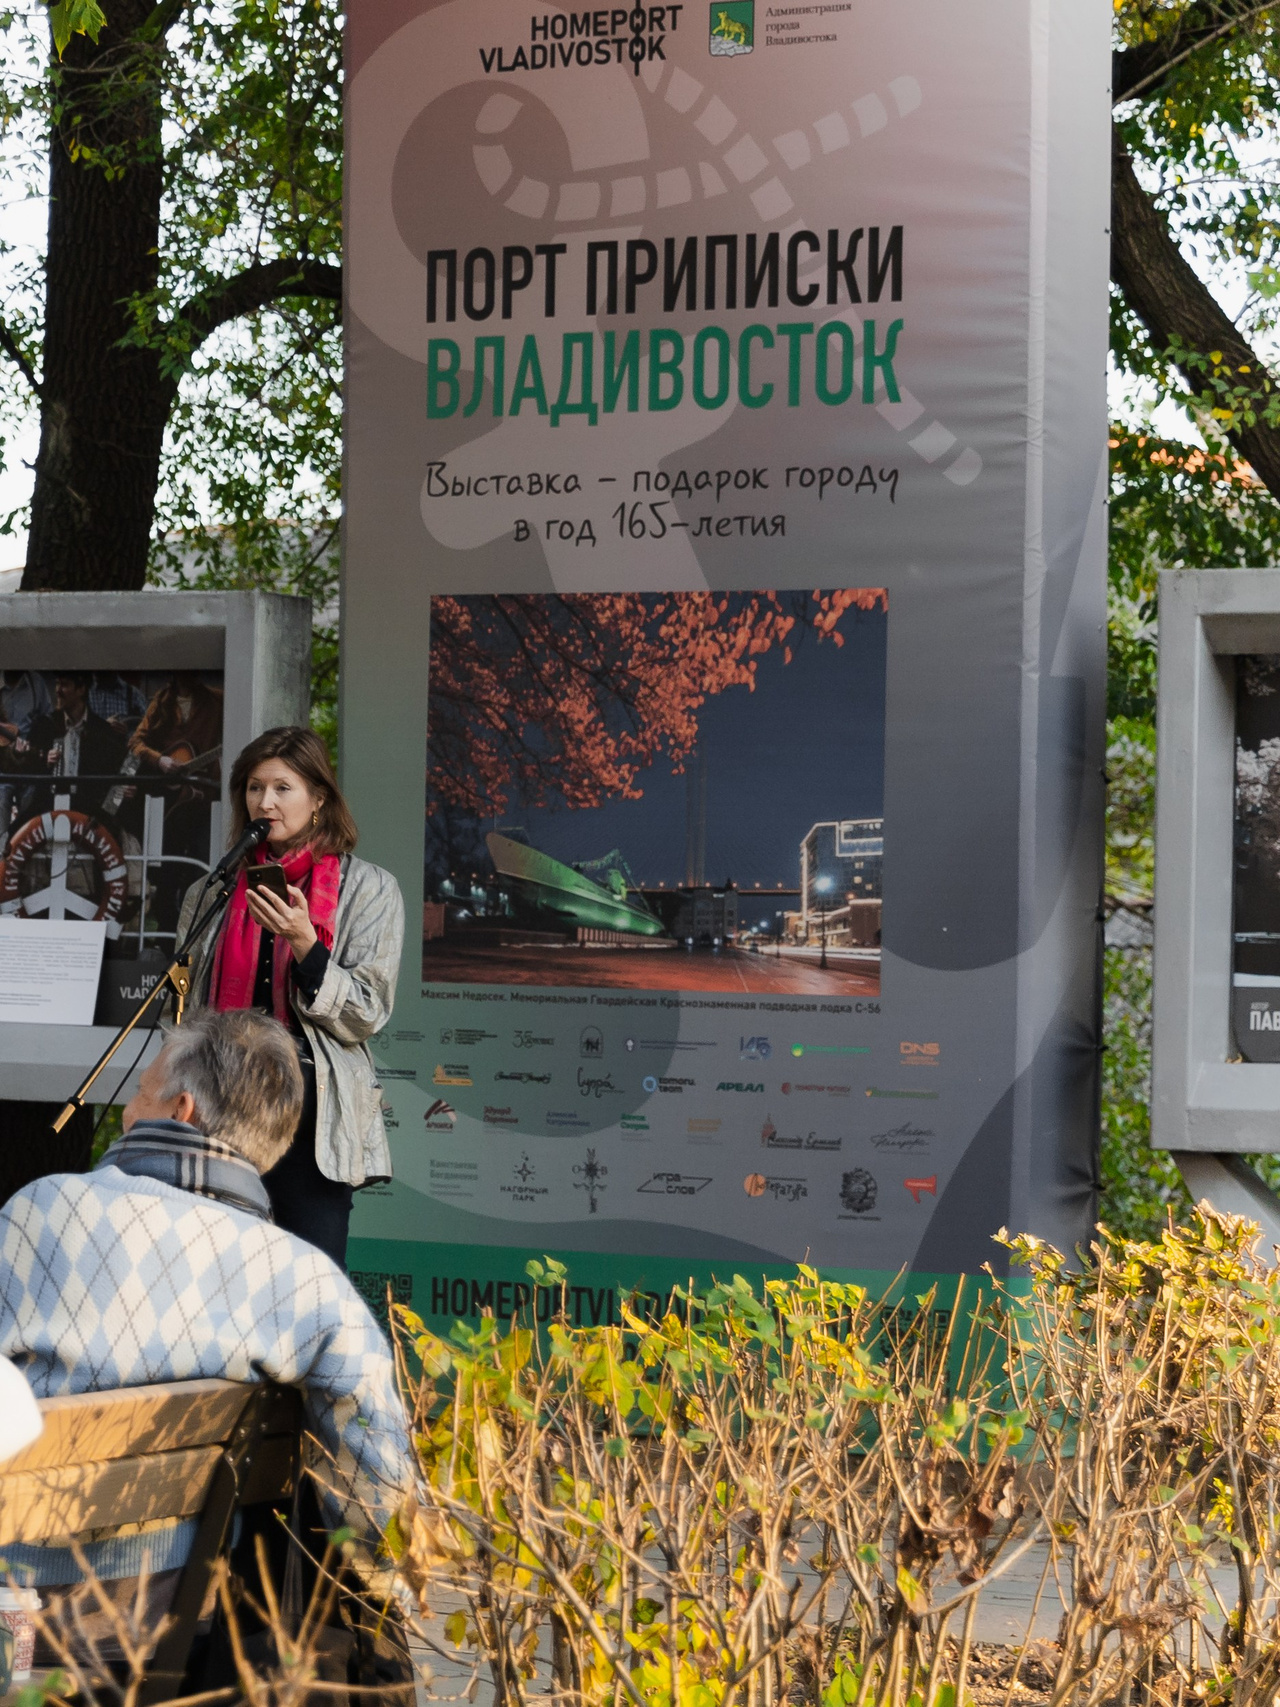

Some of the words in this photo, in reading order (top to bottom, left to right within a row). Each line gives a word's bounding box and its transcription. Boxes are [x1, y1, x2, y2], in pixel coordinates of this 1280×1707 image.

[765, 3, 852, 17] Администрация
[531, 4, 683, 41] HOMEPORT
[765, 21, 801, 33] города
[765, 33, 838, 47] Владивостока
[479, 35, 666, 73] VLADIVOSTOK
[426, 243, 567, 323] ПОРТ
[586, 225, 904, 316] ПРИПИСКИ
[426, 318, 904, 427] ВЛАДИВОСТОК
[425, 462, 581, 497] Выставка
[633, 466, 769, 502] подарок
[785, 464, 900, 503] городу
[513, 518, 531, 542] в
[545, 517, 597, 547] год
[612, 501, 786, 539] 165-летия
[421, 989, 460, 1001] Максим
[510, 992, 588, 1005] Мемориальная
[590, 993, 657, 1007] Гвардейская
[659, 996, 756, 1010] Краснознаменная
[758, 1000, 818, 1013] подводная
[819, 1002, 853, 1014] лодка
[854, 1002, 881, 1015] С-56
[899, 1041, 940, 1056] DNS
[716, 1082, 764, 1092] АРЕАЛ
[512, 1195, 536, 1203] ПАРК
[666, 1185, 695, 1195] слов
